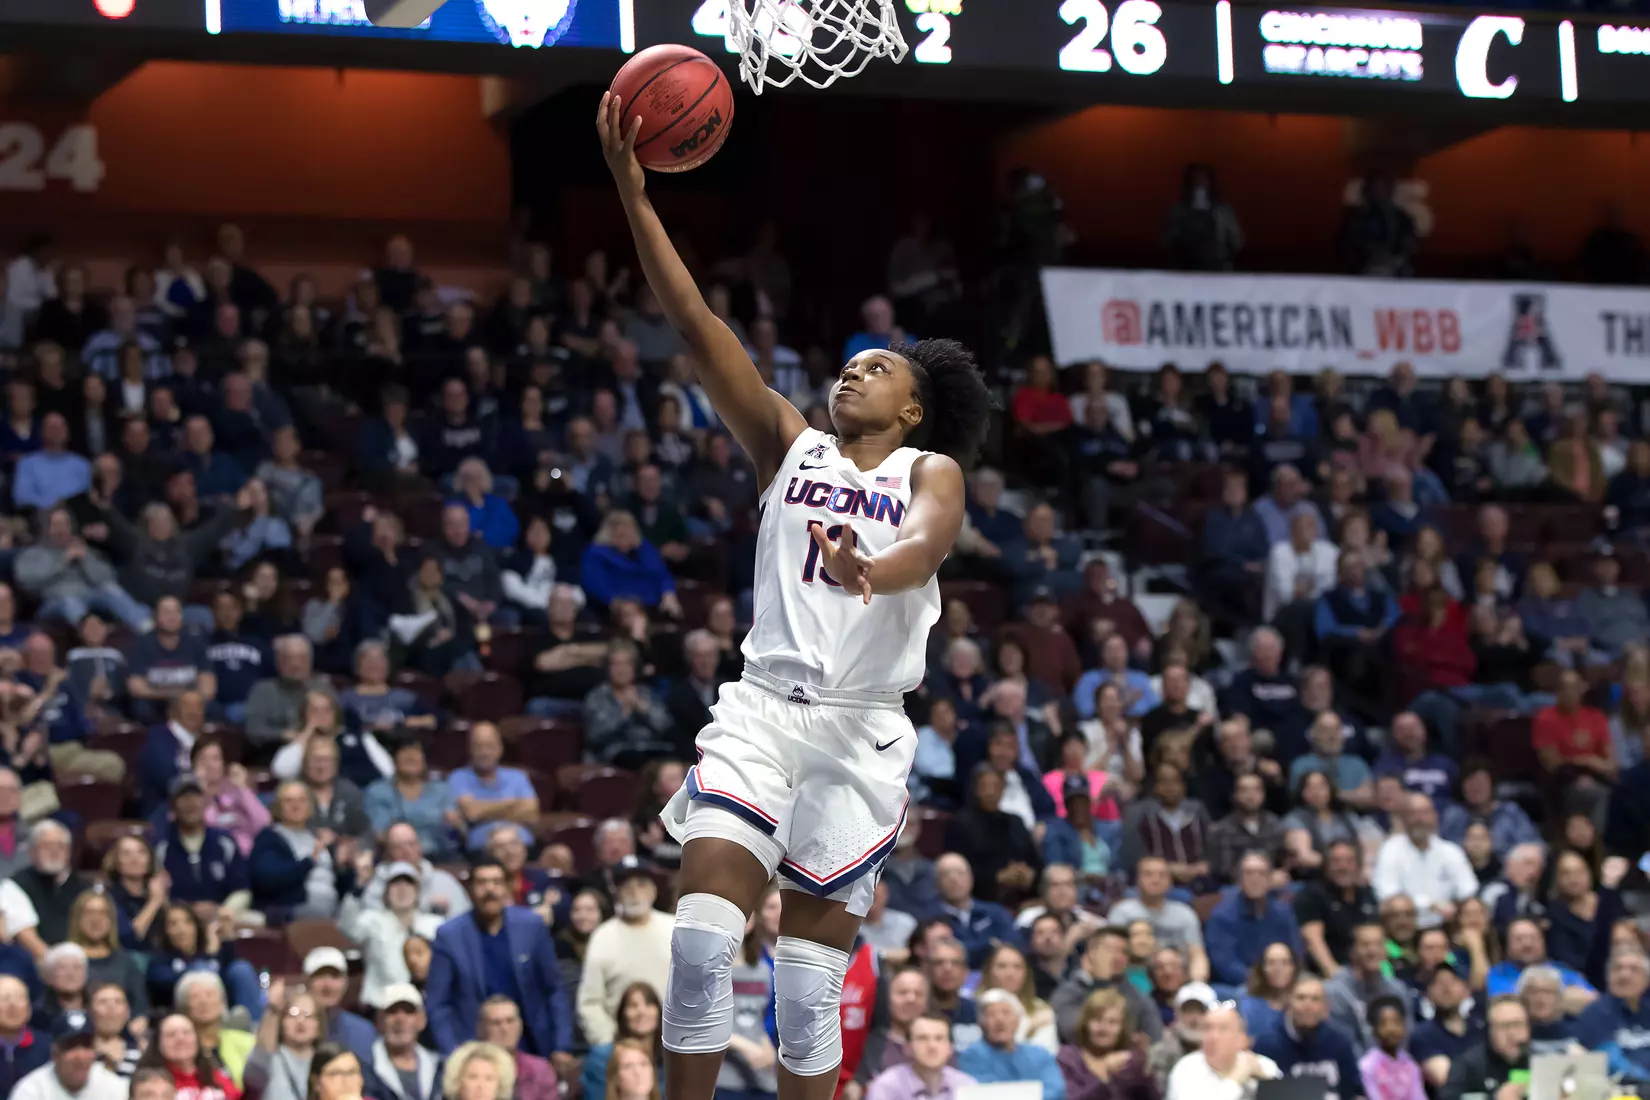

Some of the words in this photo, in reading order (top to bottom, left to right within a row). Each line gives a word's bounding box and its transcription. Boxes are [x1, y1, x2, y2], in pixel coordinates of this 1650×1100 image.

[914, 12, 952, 64] 2
[1058, 0, 1167, 74] 26
[669, 107, 722, 158] NCAA
[1102, 299, 1462, 359] @AMERICAN_WBB
[1599, 311, 1650, 357] TH
[784, 477, 907, 528] UCONN
[788, 695, 810, 705] UCONN
